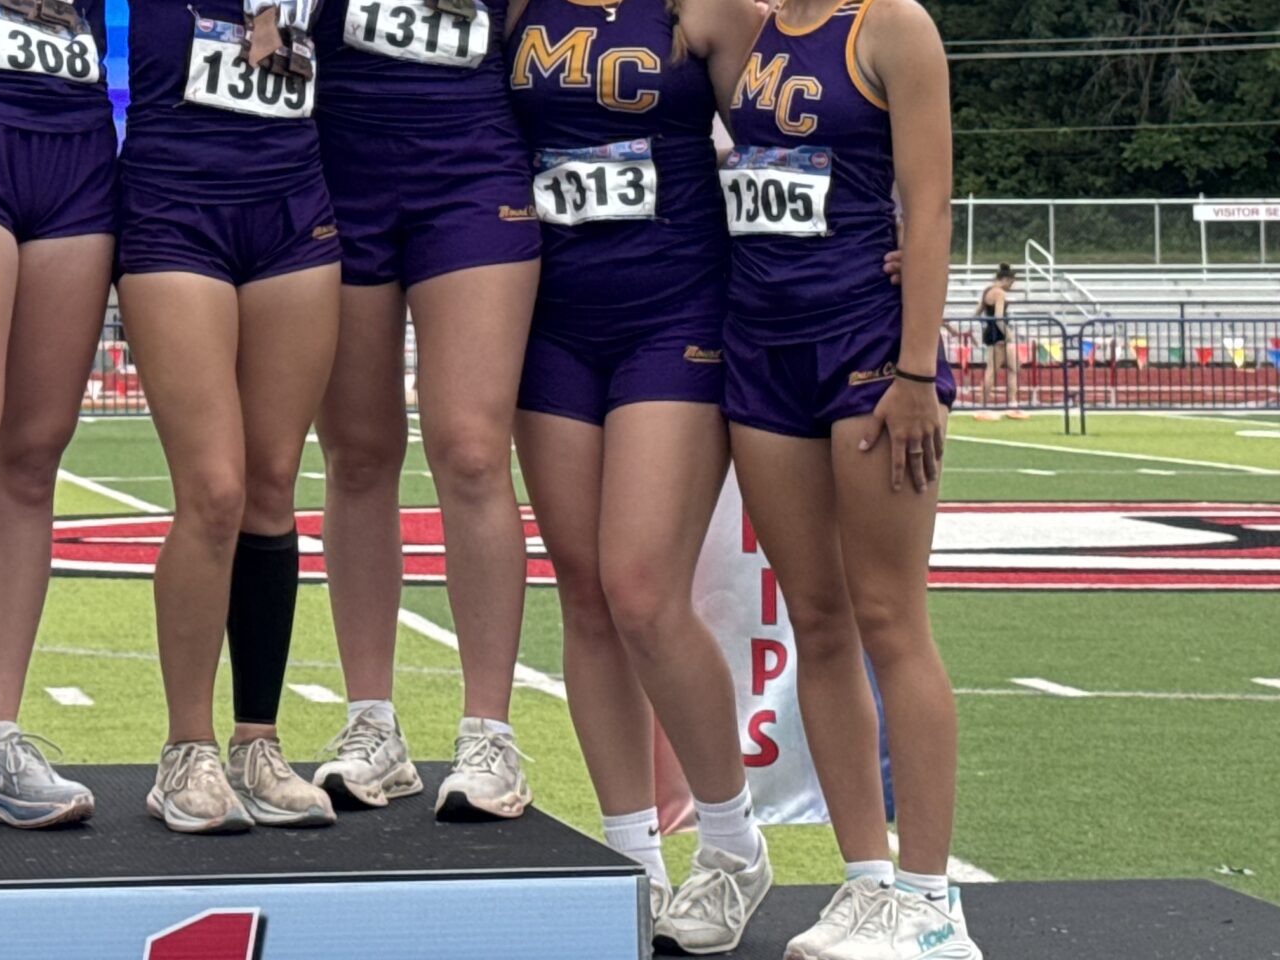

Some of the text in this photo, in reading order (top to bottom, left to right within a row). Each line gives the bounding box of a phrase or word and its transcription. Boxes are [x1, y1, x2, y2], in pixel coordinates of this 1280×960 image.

[360, 1, 471, 58] 1311
[203, 50, 306, 110] 1309
[510, 24, 662, 114] MC
[729, 51, 823, 138] MC
[544, 165, 646, 215] 1313
[728, 178, 815, 223] 1305
[1212, 207, 1260, 218] VISITOR
[916, 921, 955, 953] HOKA
